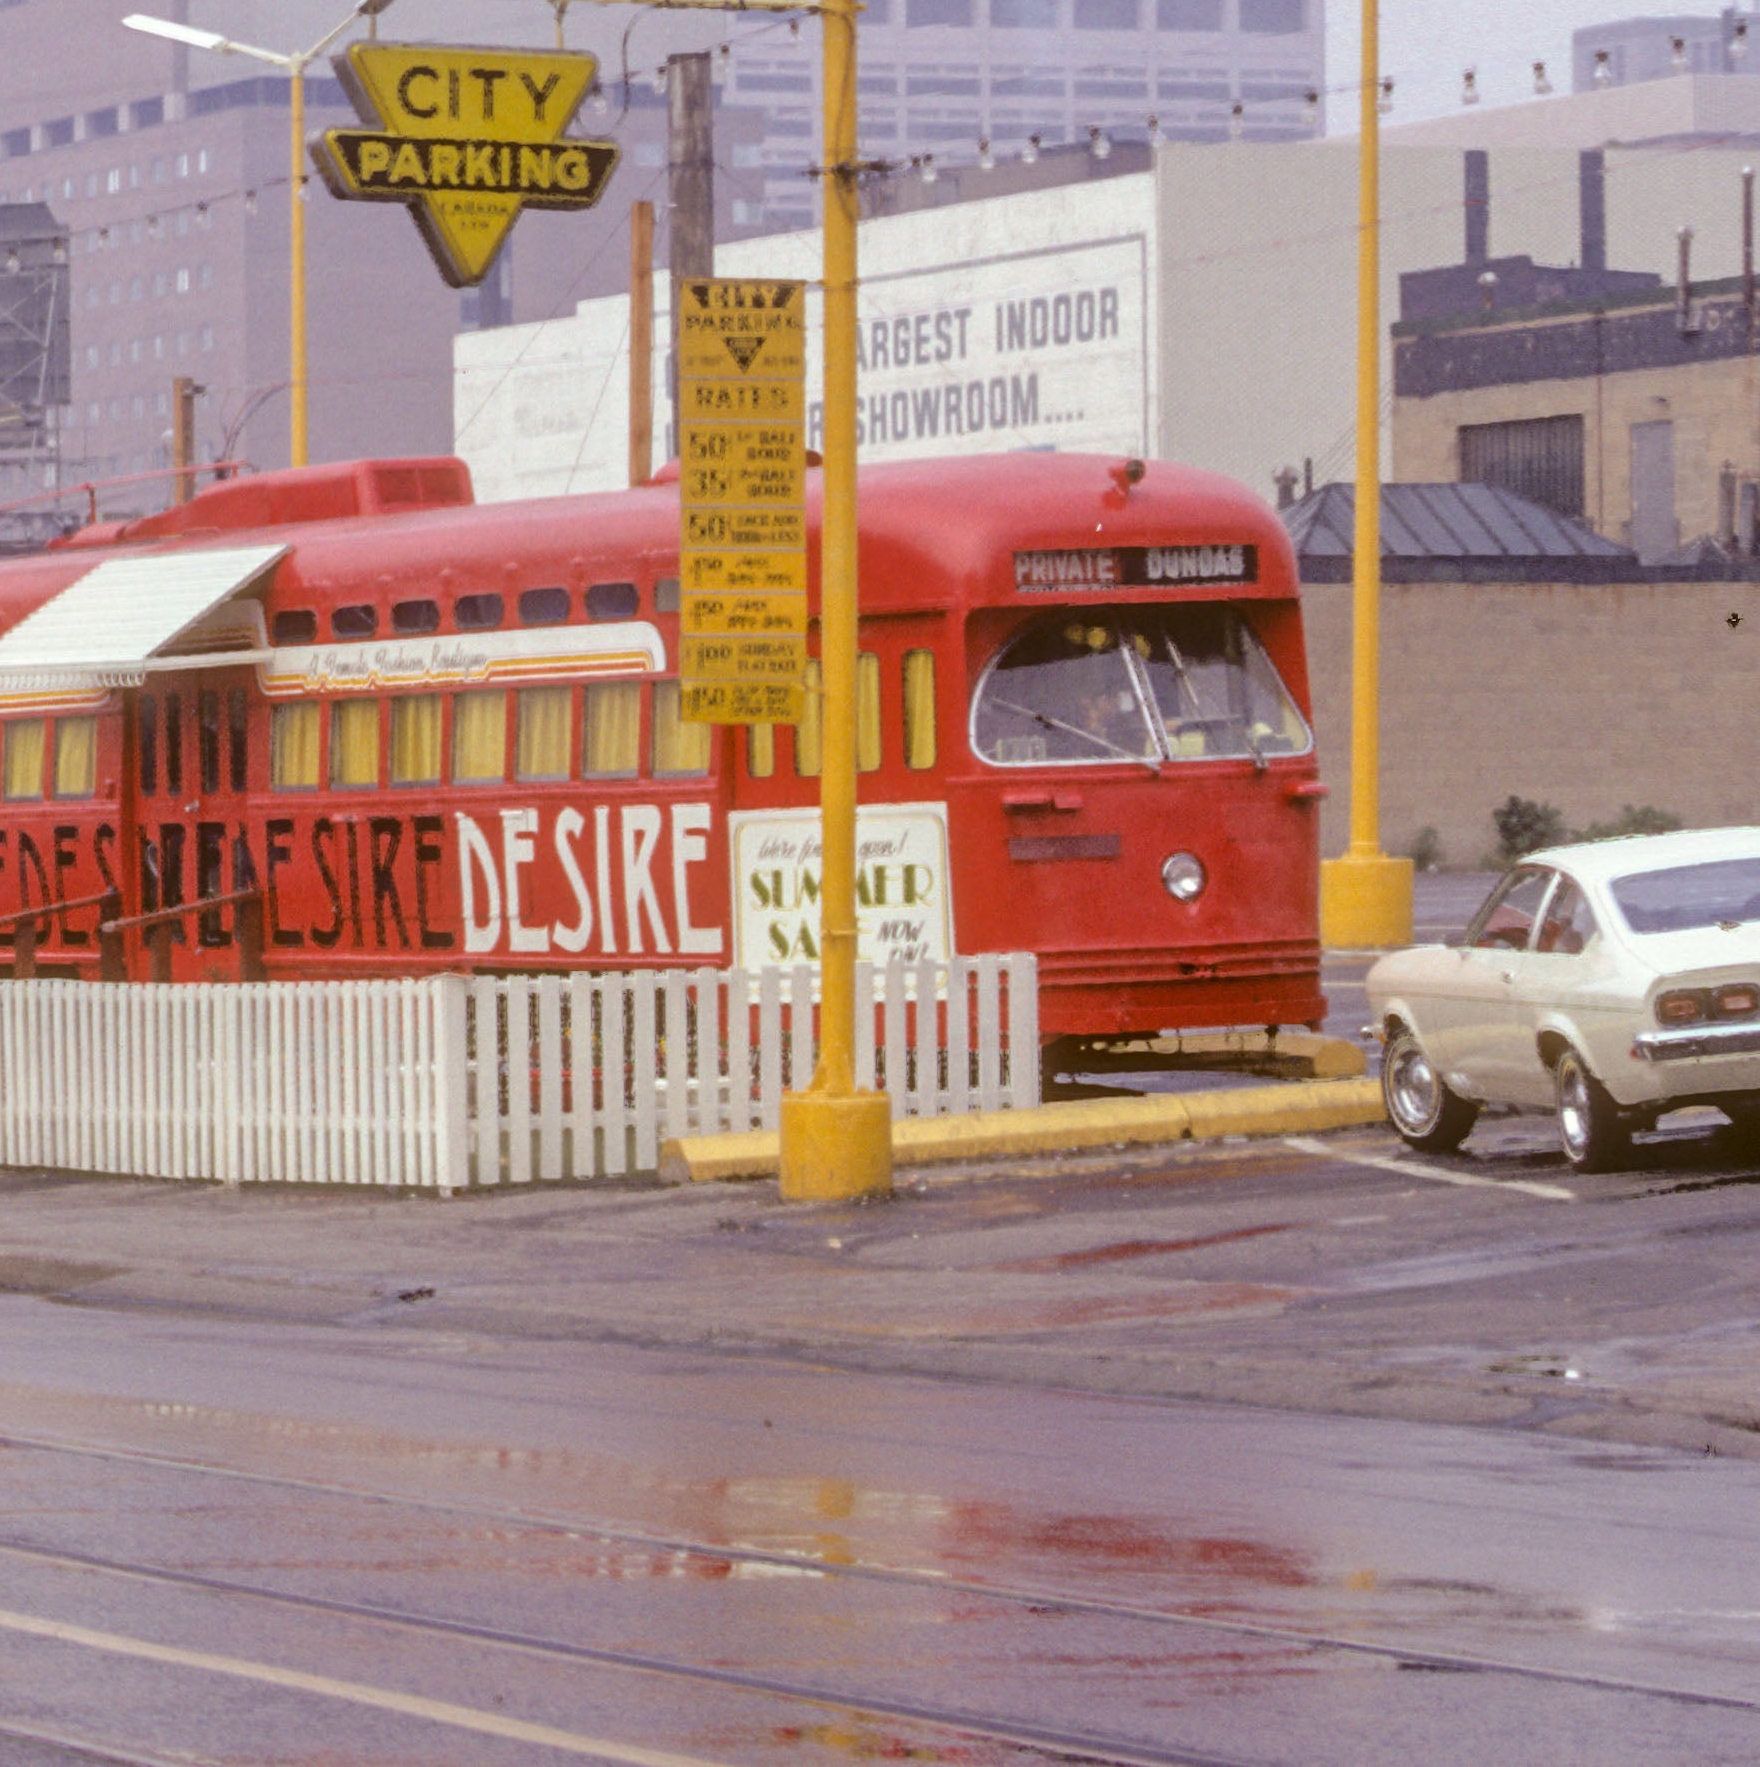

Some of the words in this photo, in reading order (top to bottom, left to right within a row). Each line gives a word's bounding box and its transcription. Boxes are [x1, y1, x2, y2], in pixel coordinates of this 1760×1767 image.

[398, 66, 560, 122] CITY
[357, 141, 591, 190] PARKING
[857, 309, 972, 372] ARGEST
[996, 286, 1119, 353] INDOOR
[1016, 551, 1115, 581] PRIVATE
[1146, 545, 1244, 579] DUNDAS
[455, 804, 723, 956] DESIRE
[877, 919, 925, 942] NOW
